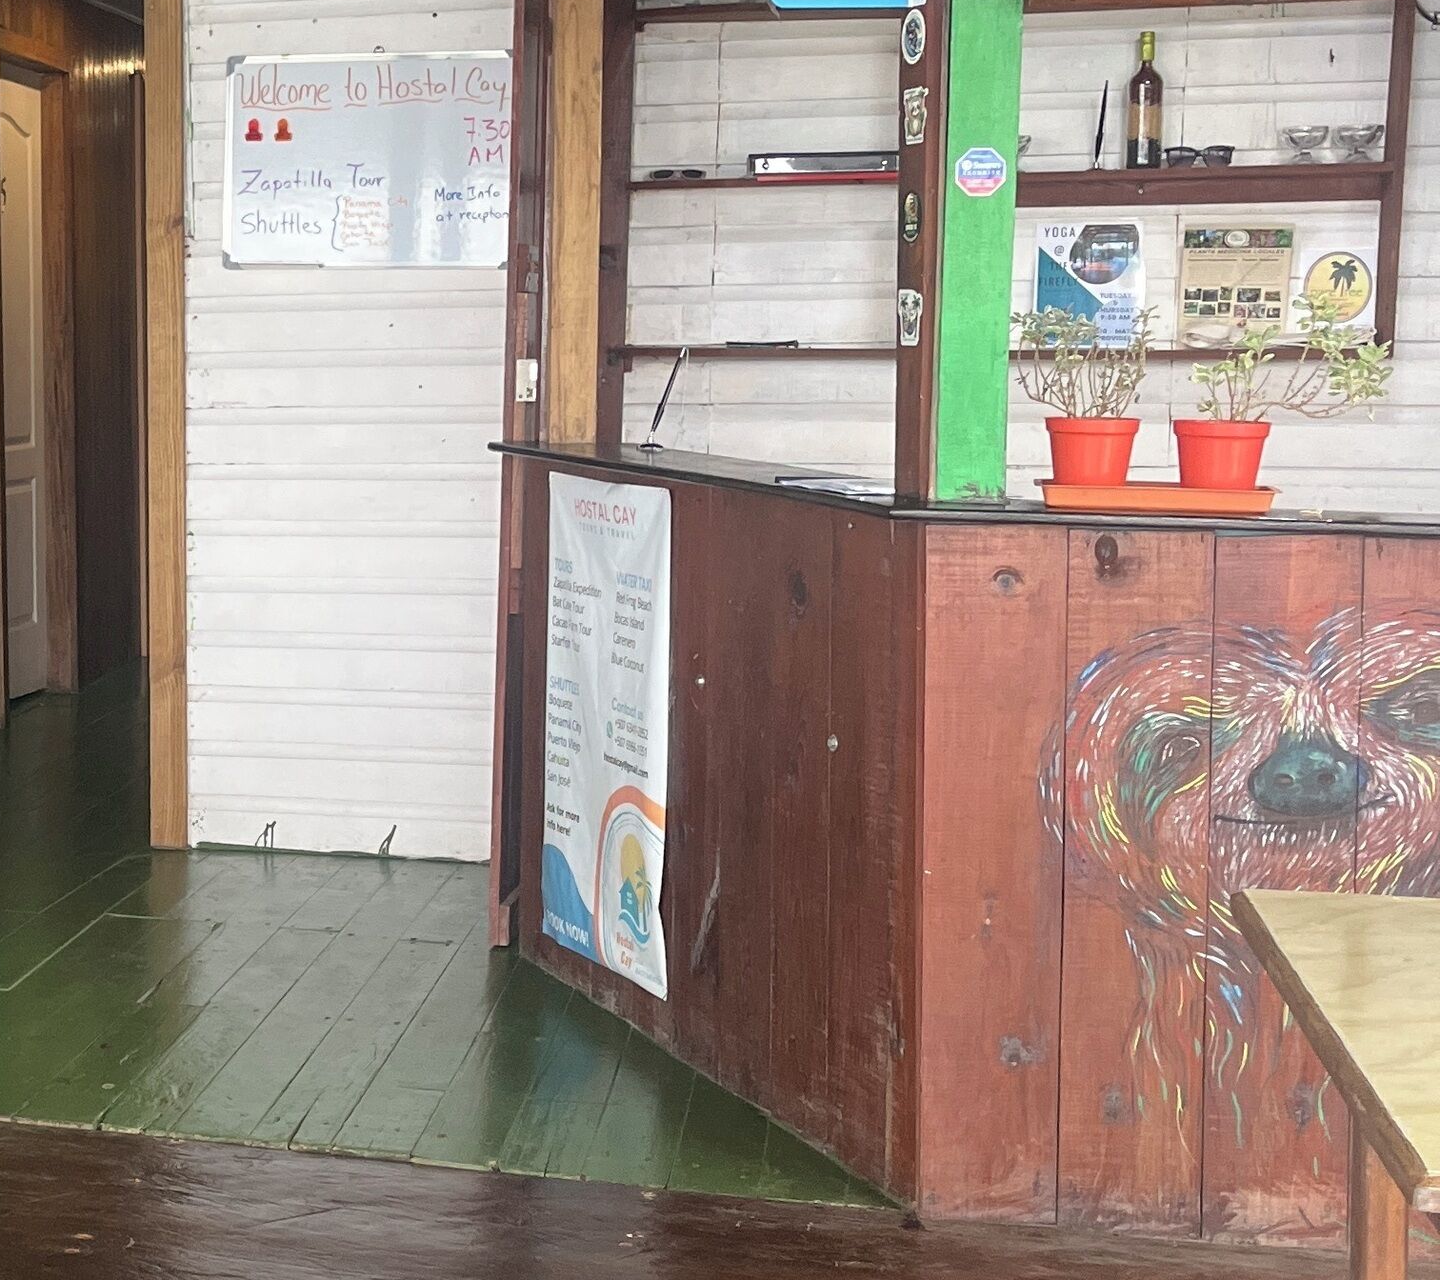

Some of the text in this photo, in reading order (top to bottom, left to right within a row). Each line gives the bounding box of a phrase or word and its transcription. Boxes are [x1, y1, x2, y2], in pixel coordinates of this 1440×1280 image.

[235, 64, 507, 112] Welcome to Hostal Cay
[237, 163, 386, 200] Zapatilla Tour
[434, 184, 501, 202] More Info
[241, 209, 322, 235] Shuttles
[436, 211, 453, 222] at
[1044, 226, 1076, 238] YOGA
[1054, 245, 1065, 257] @
[575, 499, 637, 527] HOSTAL CAY
[573, 601, 585, 615] Tour
[579, 622, 592, 636] Tour
[565, 921, 590, 948] NOW!
